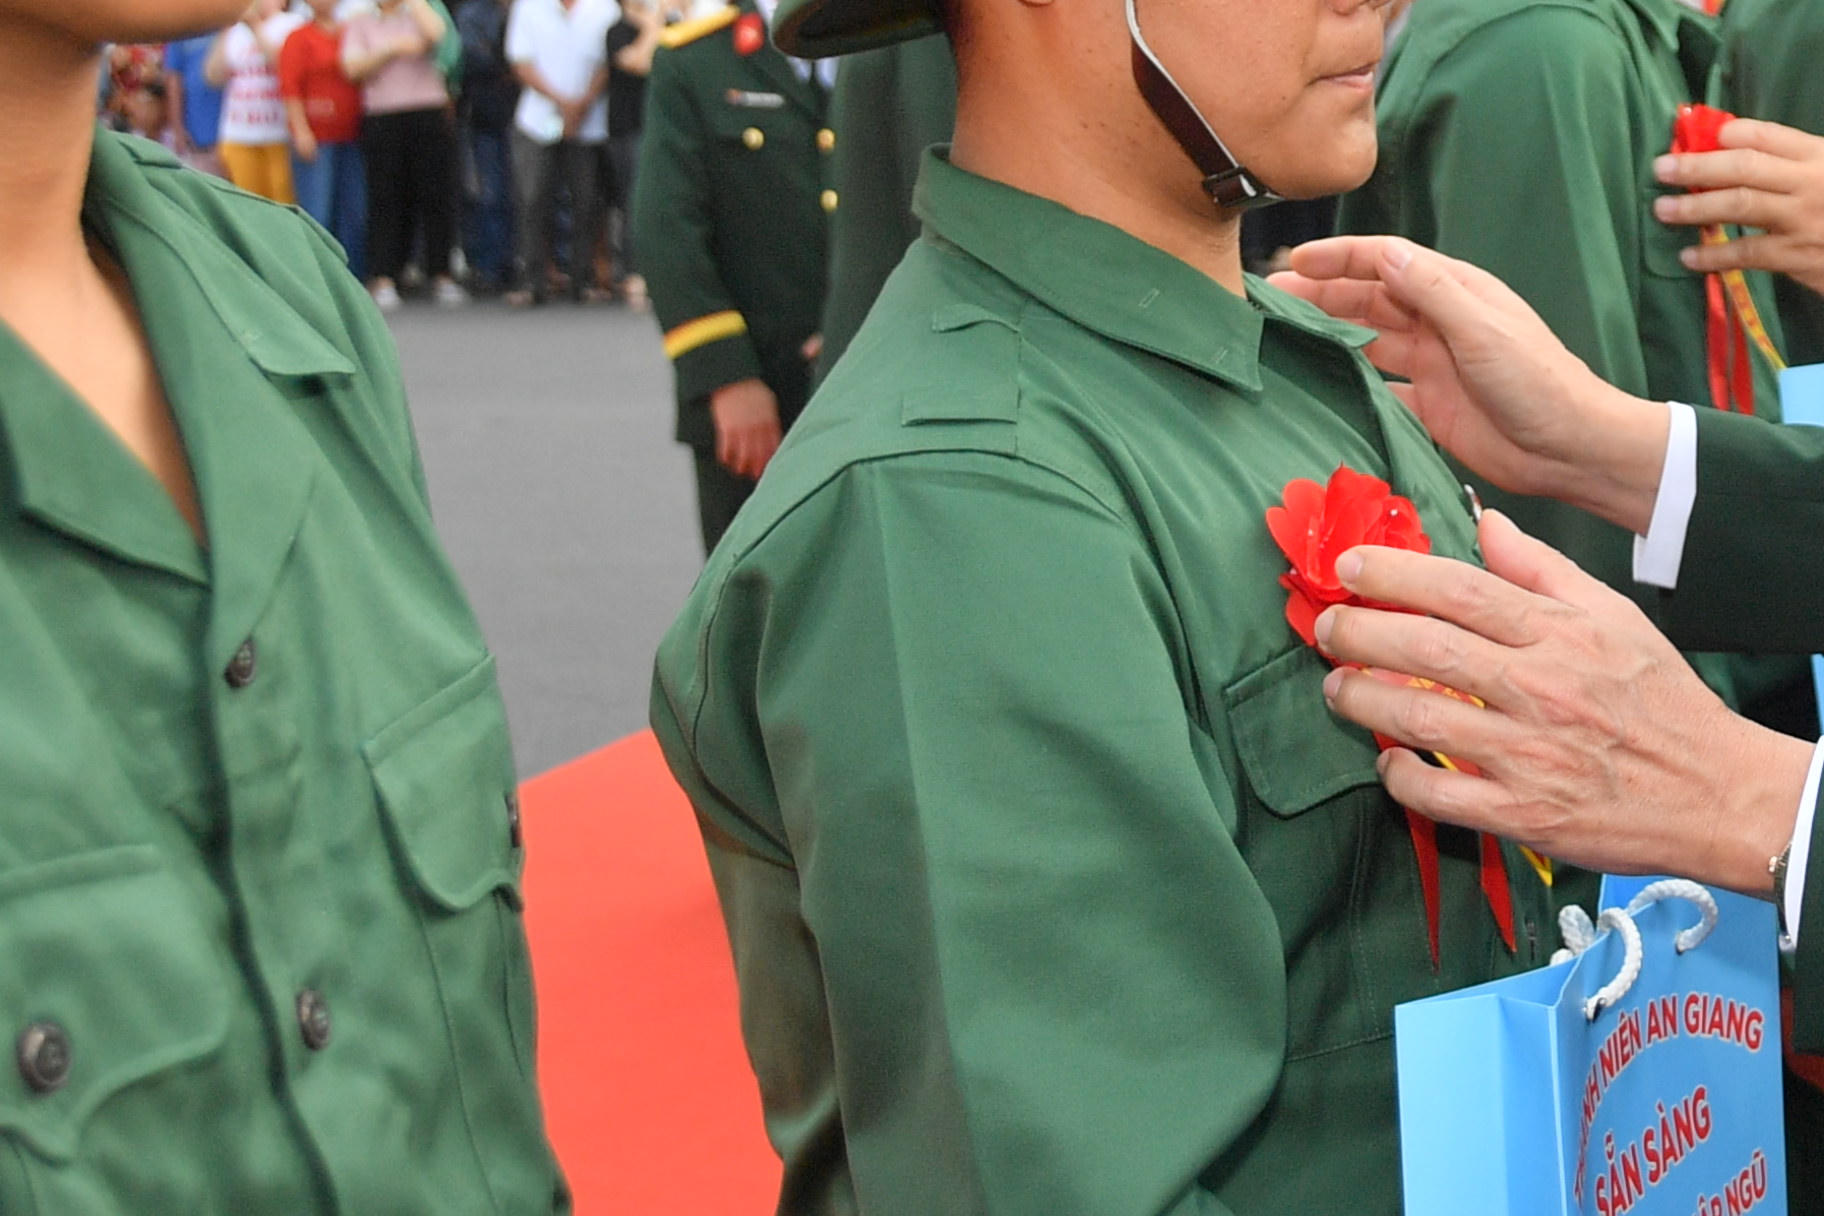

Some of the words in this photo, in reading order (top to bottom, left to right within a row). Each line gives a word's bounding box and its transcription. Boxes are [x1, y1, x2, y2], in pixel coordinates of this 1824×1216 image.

[1599, 1010, 1643, 1088] NIÊN
[1646, 994, 1679, 1047] AN
[1684, 992, 1763, 1050] GIANG
[1643, 1086, 1712, 1185] SÀNG
